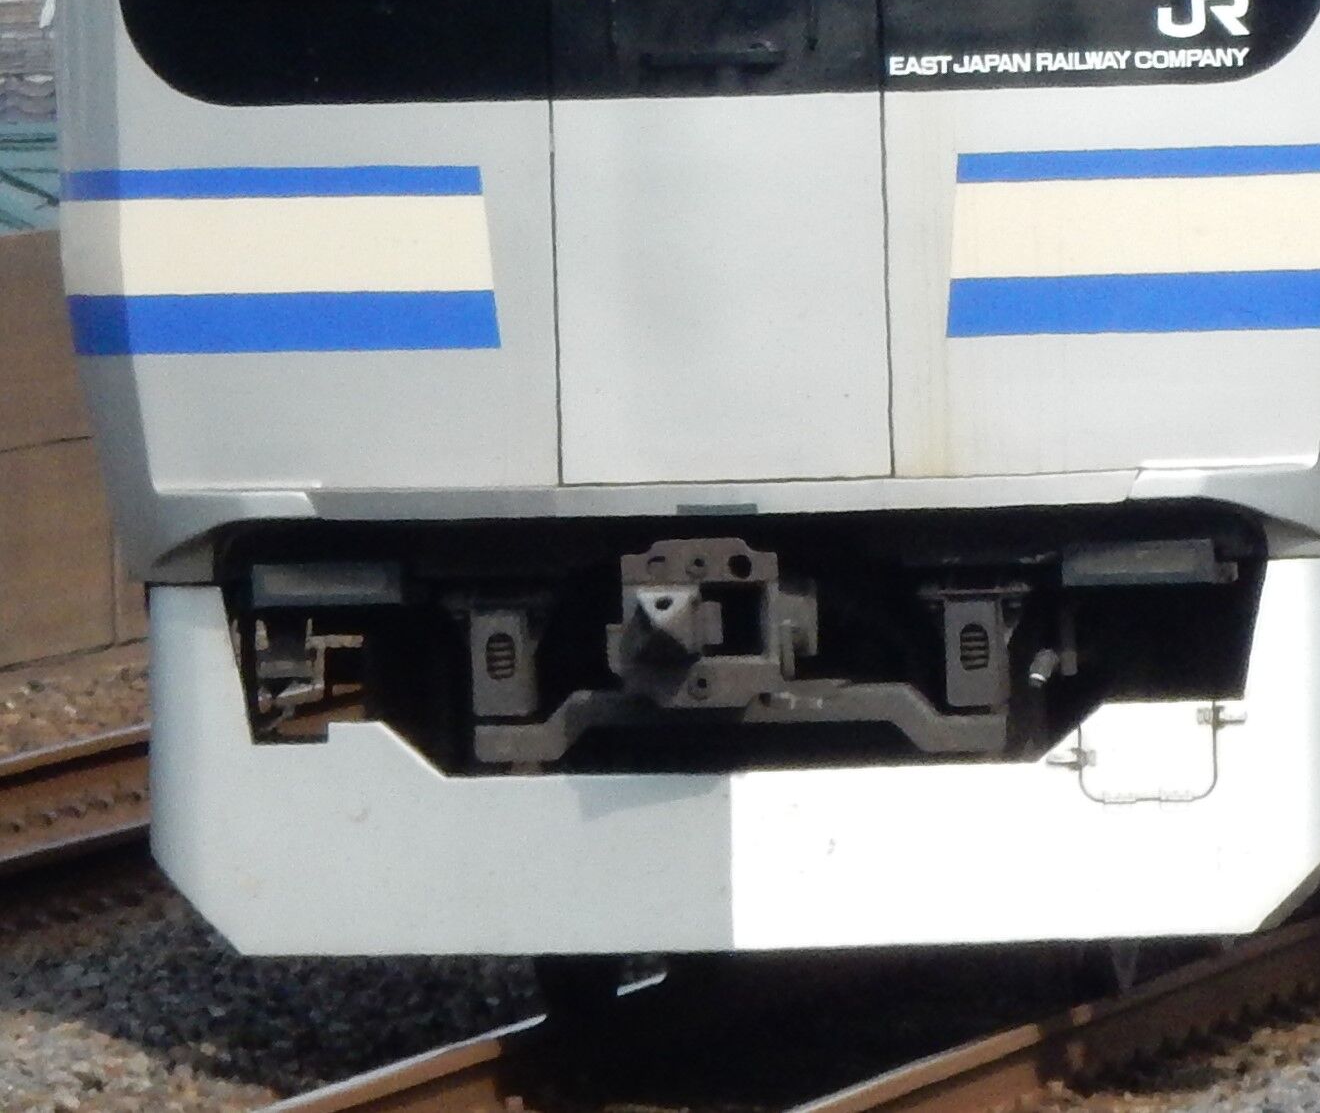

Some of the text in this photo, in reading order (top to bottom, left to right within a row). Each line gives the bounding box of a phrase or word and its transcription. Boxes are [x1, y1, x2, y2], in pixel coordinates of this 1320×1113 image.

[889, 47, 1250, 76] EAST JAPAN RAILWAY COMPANY
